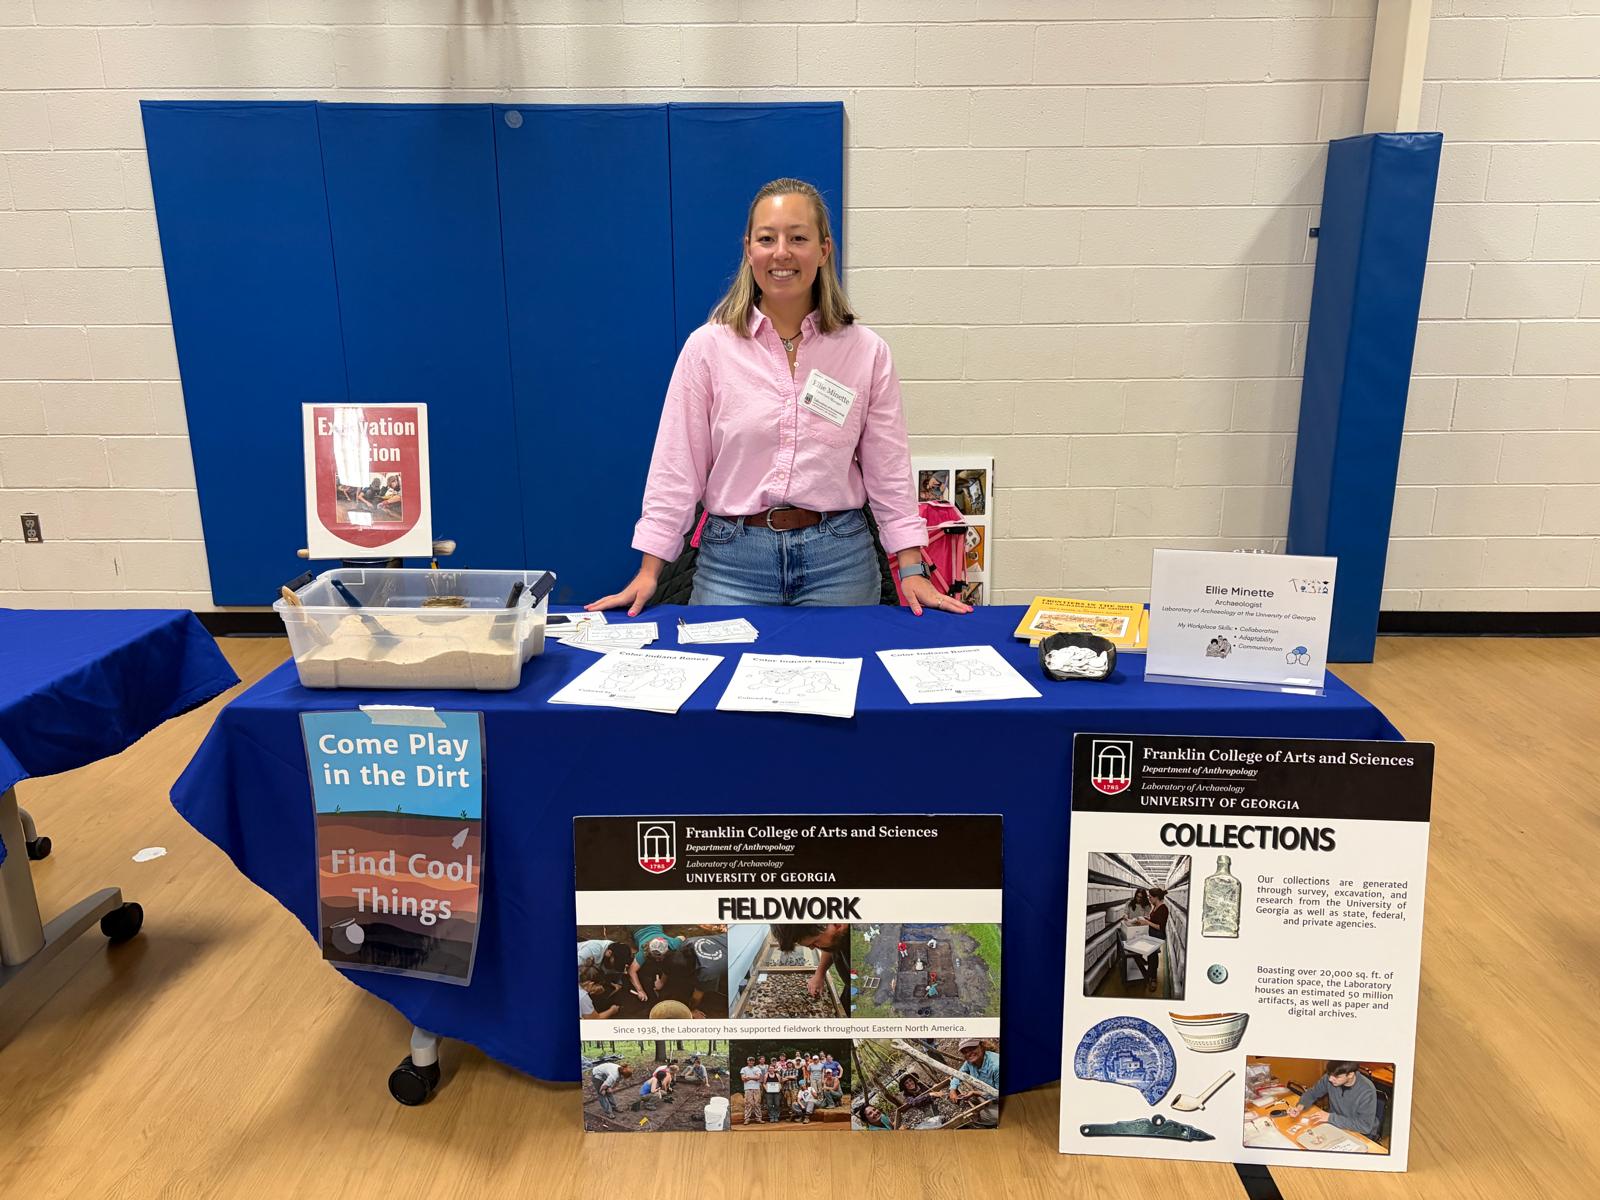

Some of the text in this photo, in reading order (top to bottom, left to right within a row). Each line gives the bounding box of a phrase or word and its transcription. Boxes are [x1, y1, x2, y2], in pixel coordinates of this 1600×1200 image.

[826, 388, 850, 406] Minette
[318, 416, 416, 436] Exvation
[1206, 586, 1274, 598] Ellie Minette
[1162, 605, 1192, 613] Laboratory
[1200, 608, 1236, 616] Archaeology
[1215, 600, 1262, 608] Archaeologist
[1239, 634, 1274, 644] Adaptability
[1238, 643, 1282, 651] Communication
[318, 732, 469, 762] Come Play
[1143, 747, 1414, 766] Franklin College of Arts and Sciences
[323, 763, 470, 788] in the Dirt
[1142, 765, 1258, 776] Department of Anthropology
[1141, 782, 1245, 793] Laboratory of Archaeology
[1140, 796, 1300, 810] UNIVERSITY OF GEORGIA
[686, 826, 938, 840] Franklin College of Arts and Sciences
[1160, 822, 1336, 852] COLLECTIONS
[686, 843, 795, 852] Department of Anthropology
[331, 848, 472, 882] Find Cool
[686, 860, 784, 869] Laboratory of Archaeology
[686, 872, 836, 883] UNIVERSITY OF GEORGIA
[1258, 875, 1274, 884] Our
[1283, 876, 1330, 886] collections
[1363, 881, 1408, 889] generated
[1257, 886, 1292, 896] through
[1297, 889, 1329, 897] survey,
[1334, 890, 1385, 899] excavation,
[352, 887, 452, 926] Things
[718, 896, 862, 920] FIELDWORK
[1299, 897, 1320, 905] from
[1346, 900, 1392, 910] University
[1256, 906, 1289, 916] Georgia
[1307, 908, 1325, 916] well
[1342, 910, 1368, 919] state,
[1372, 911, 1406, 921] federal,
[1302, 918, 1333, 927] private
[1336, 920, 1376, 929] agencies.
[1257, 966, 1295, 976] Boasting
[1320, 970, 1352, 978] 20,000
[1355, 971, 1368, 980] sq.
[1371, 971, 1381, 979] ft.
[1384, 972, 1394, 980] of
[1258, 976, 1392, 991] curation space, the Laboratory
[1254, 986, 1285, 994] houses
[1301, 988, 1345, 998] estimated
[1362, 991, 1394, 1000] million
[1258, 996, 1297, 1006] artifacts,
[1312, 998, 1329, 1006] well
[1344, 1001, 1370, 1010] paper
[1372, 1002, 1389, 1010] and
[1288, 1008, 1357, 1018] digital archives.
[637, 1027, 660, 1035] 1938,
[677, 1026, 721, 1035] Laboratory
[740, 1026, 781, 1035] supported
[783, 1024, 821, 1032] fieldwork
[823, 1025, 870, 1034] throughout
[930, 1024, 967, 1032] America.
